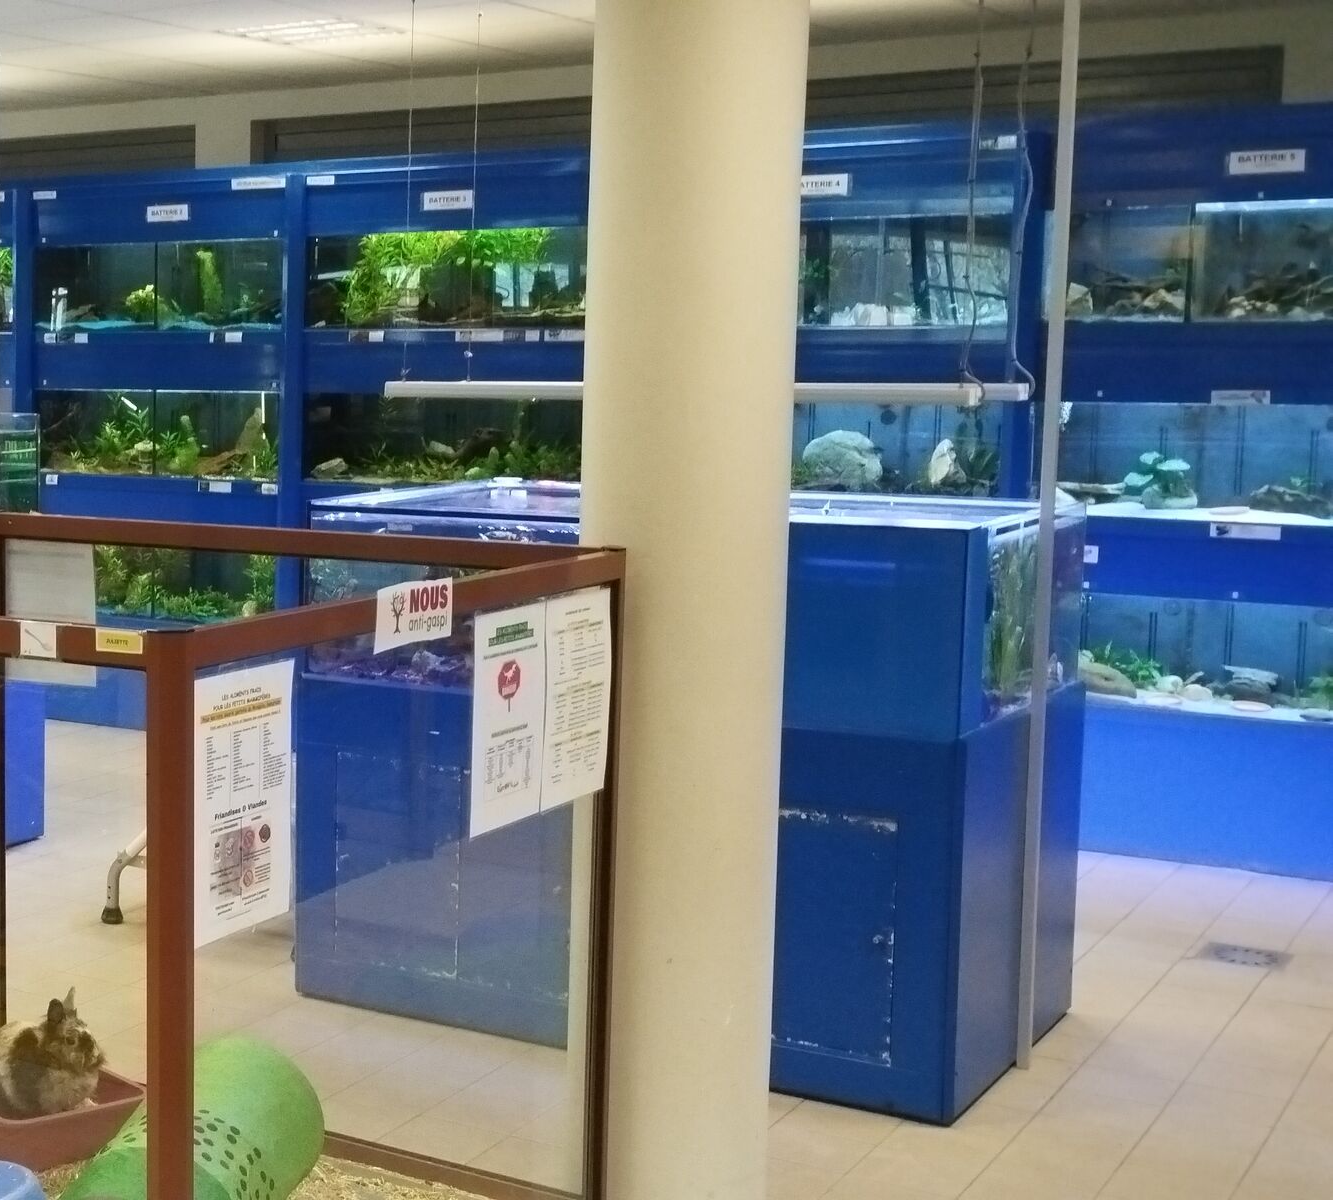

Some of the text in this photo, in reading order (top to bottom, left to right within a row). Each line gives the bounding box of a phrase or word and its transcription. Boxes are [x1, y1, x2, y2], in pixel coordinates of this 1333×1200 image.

[1238, 154, 1286, 163] BATTERIE
[428, 196, 461, 204] BATTERIE
[409, 584, 448, 613] NOUS
[408, 611, 448, 632] anti-gaspi
[214, 807, 241, 821] Friandises
[247, 800, 268, 811] Viandes
